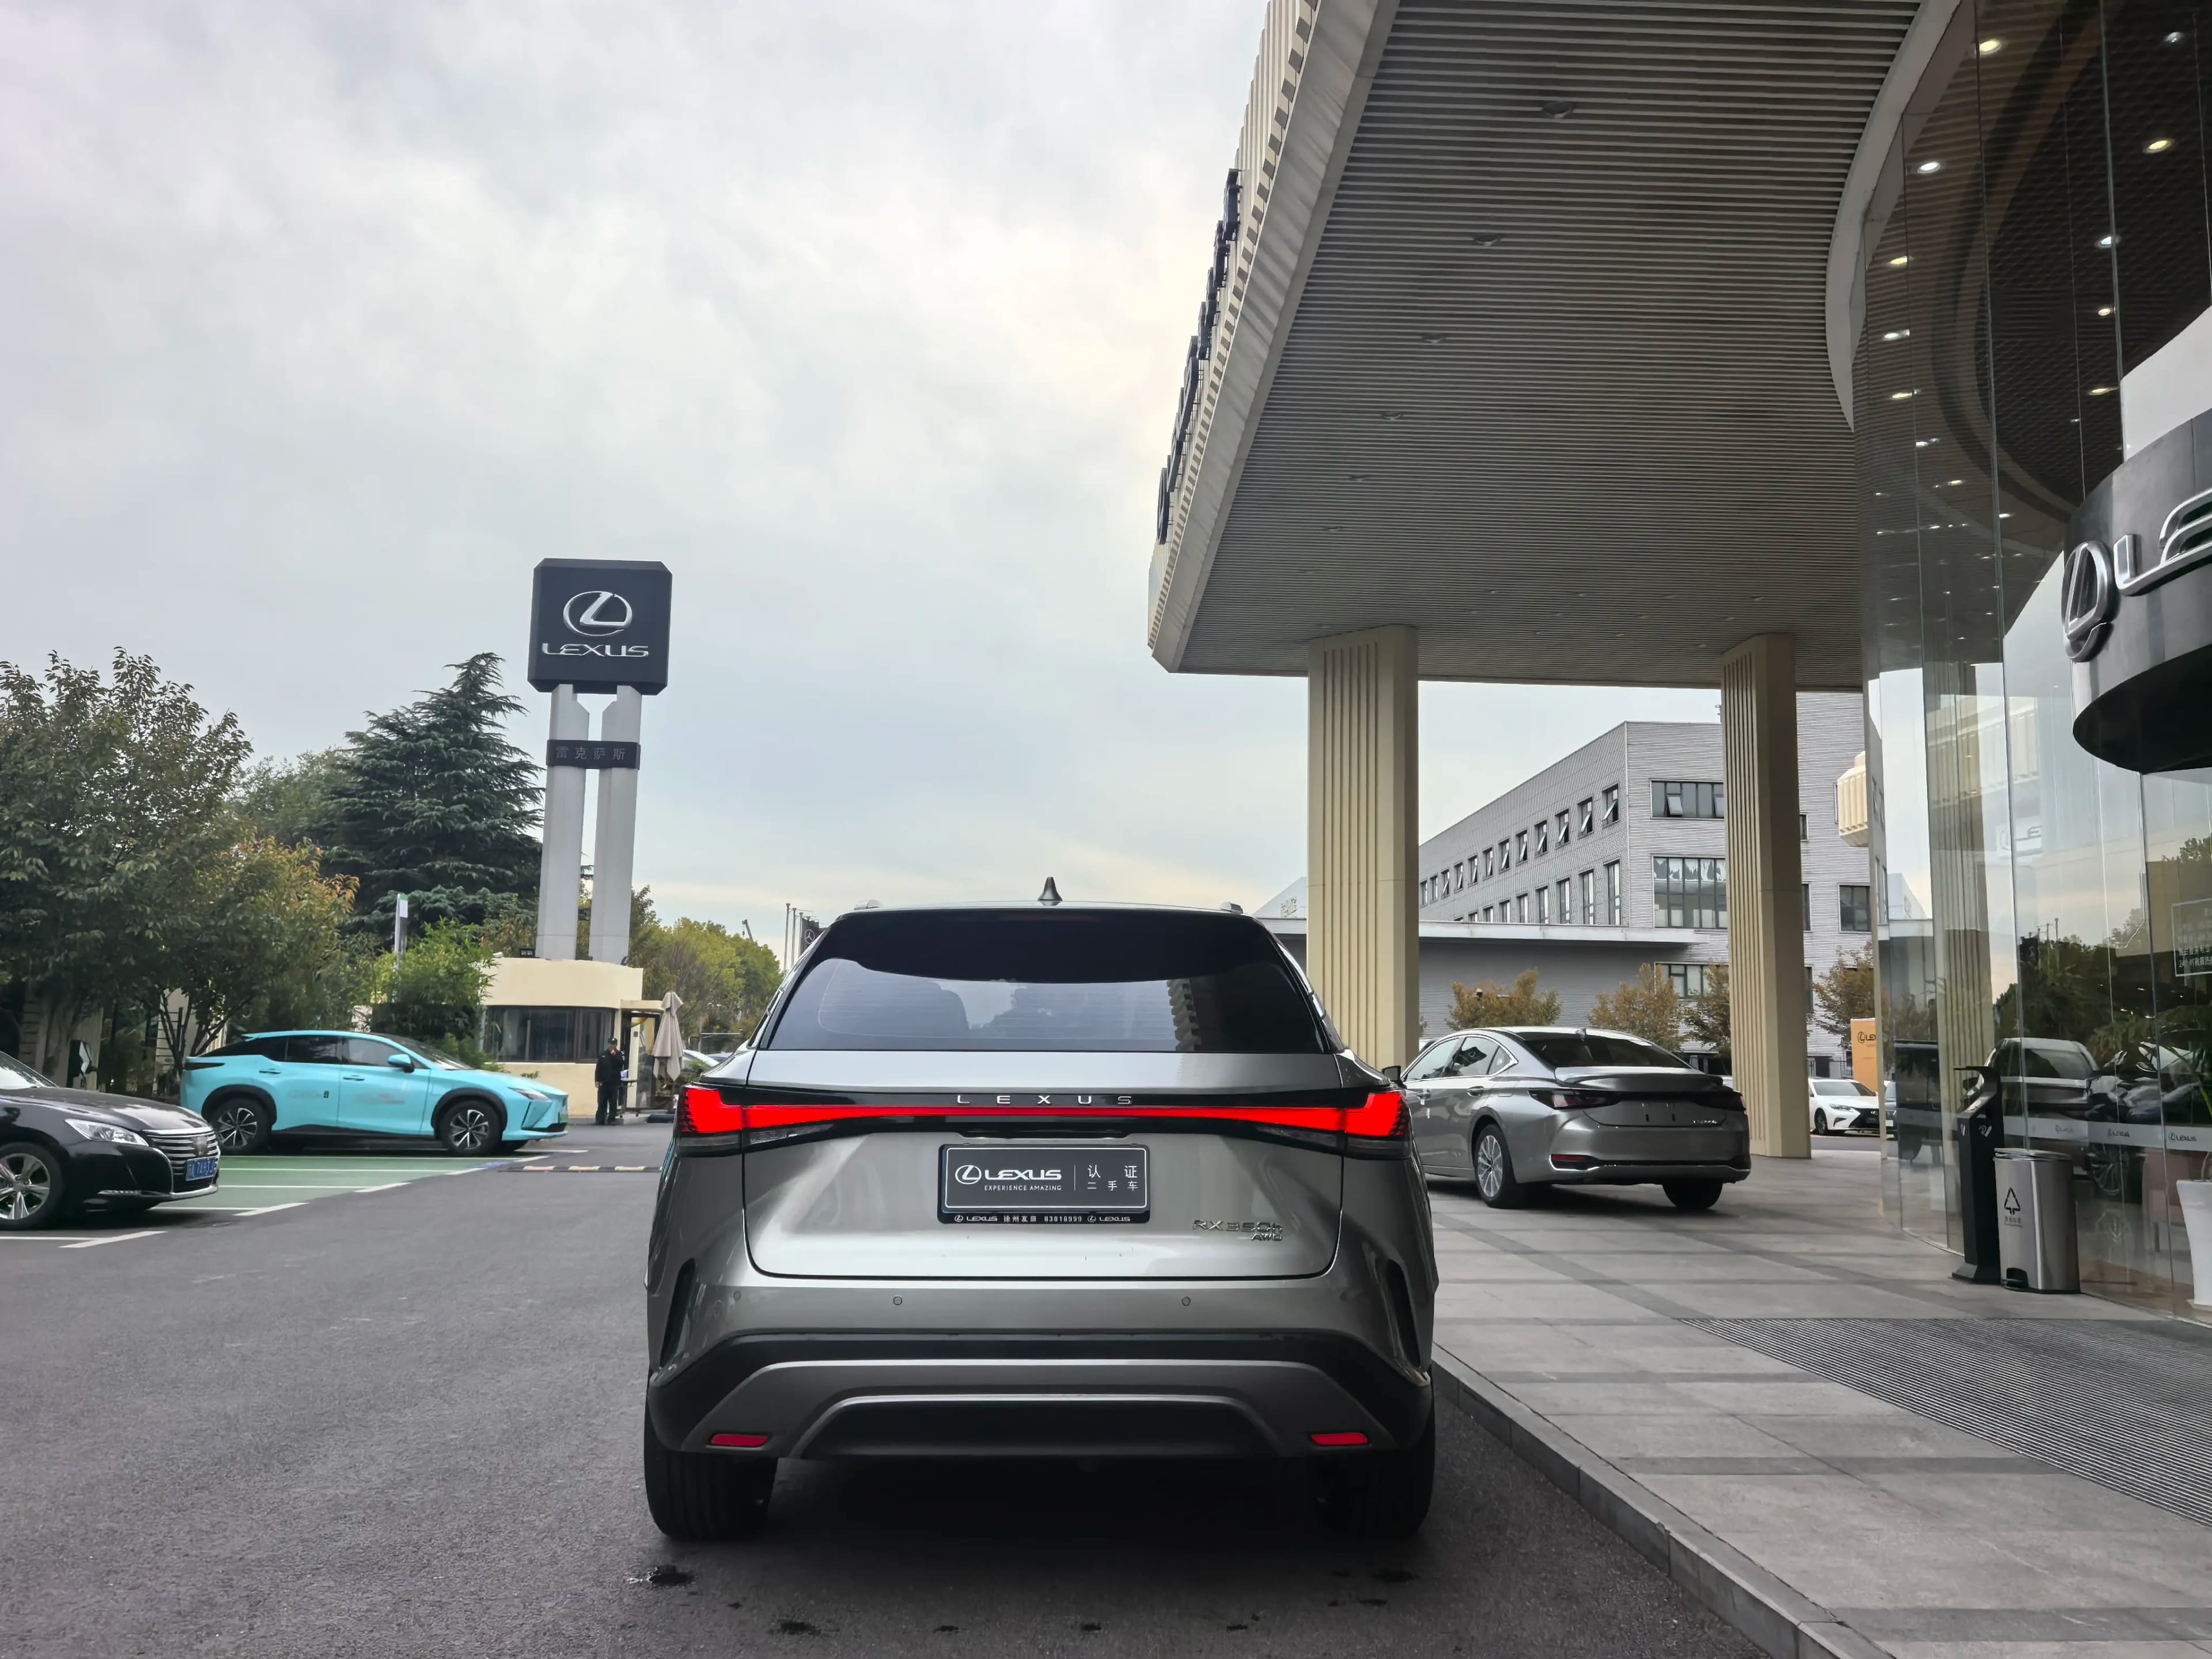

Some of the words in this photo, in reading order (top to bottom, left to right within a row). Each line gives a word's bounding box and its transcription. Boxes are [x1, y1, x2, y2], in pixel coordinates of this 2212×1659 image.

[542, 643, 649, 657] LEXUS
[556, 746, 626, 760] 雷克萨斯
[957, 1094, 1132, 1105] LEXUS
[984, 1169, 1062, 1180] LEXUS
[1088, 1164, 1138, 1179] 认证
[1087, 1180, 1138, 1192] 二手车
[1251, 1233, 1283, 1241] AWD
